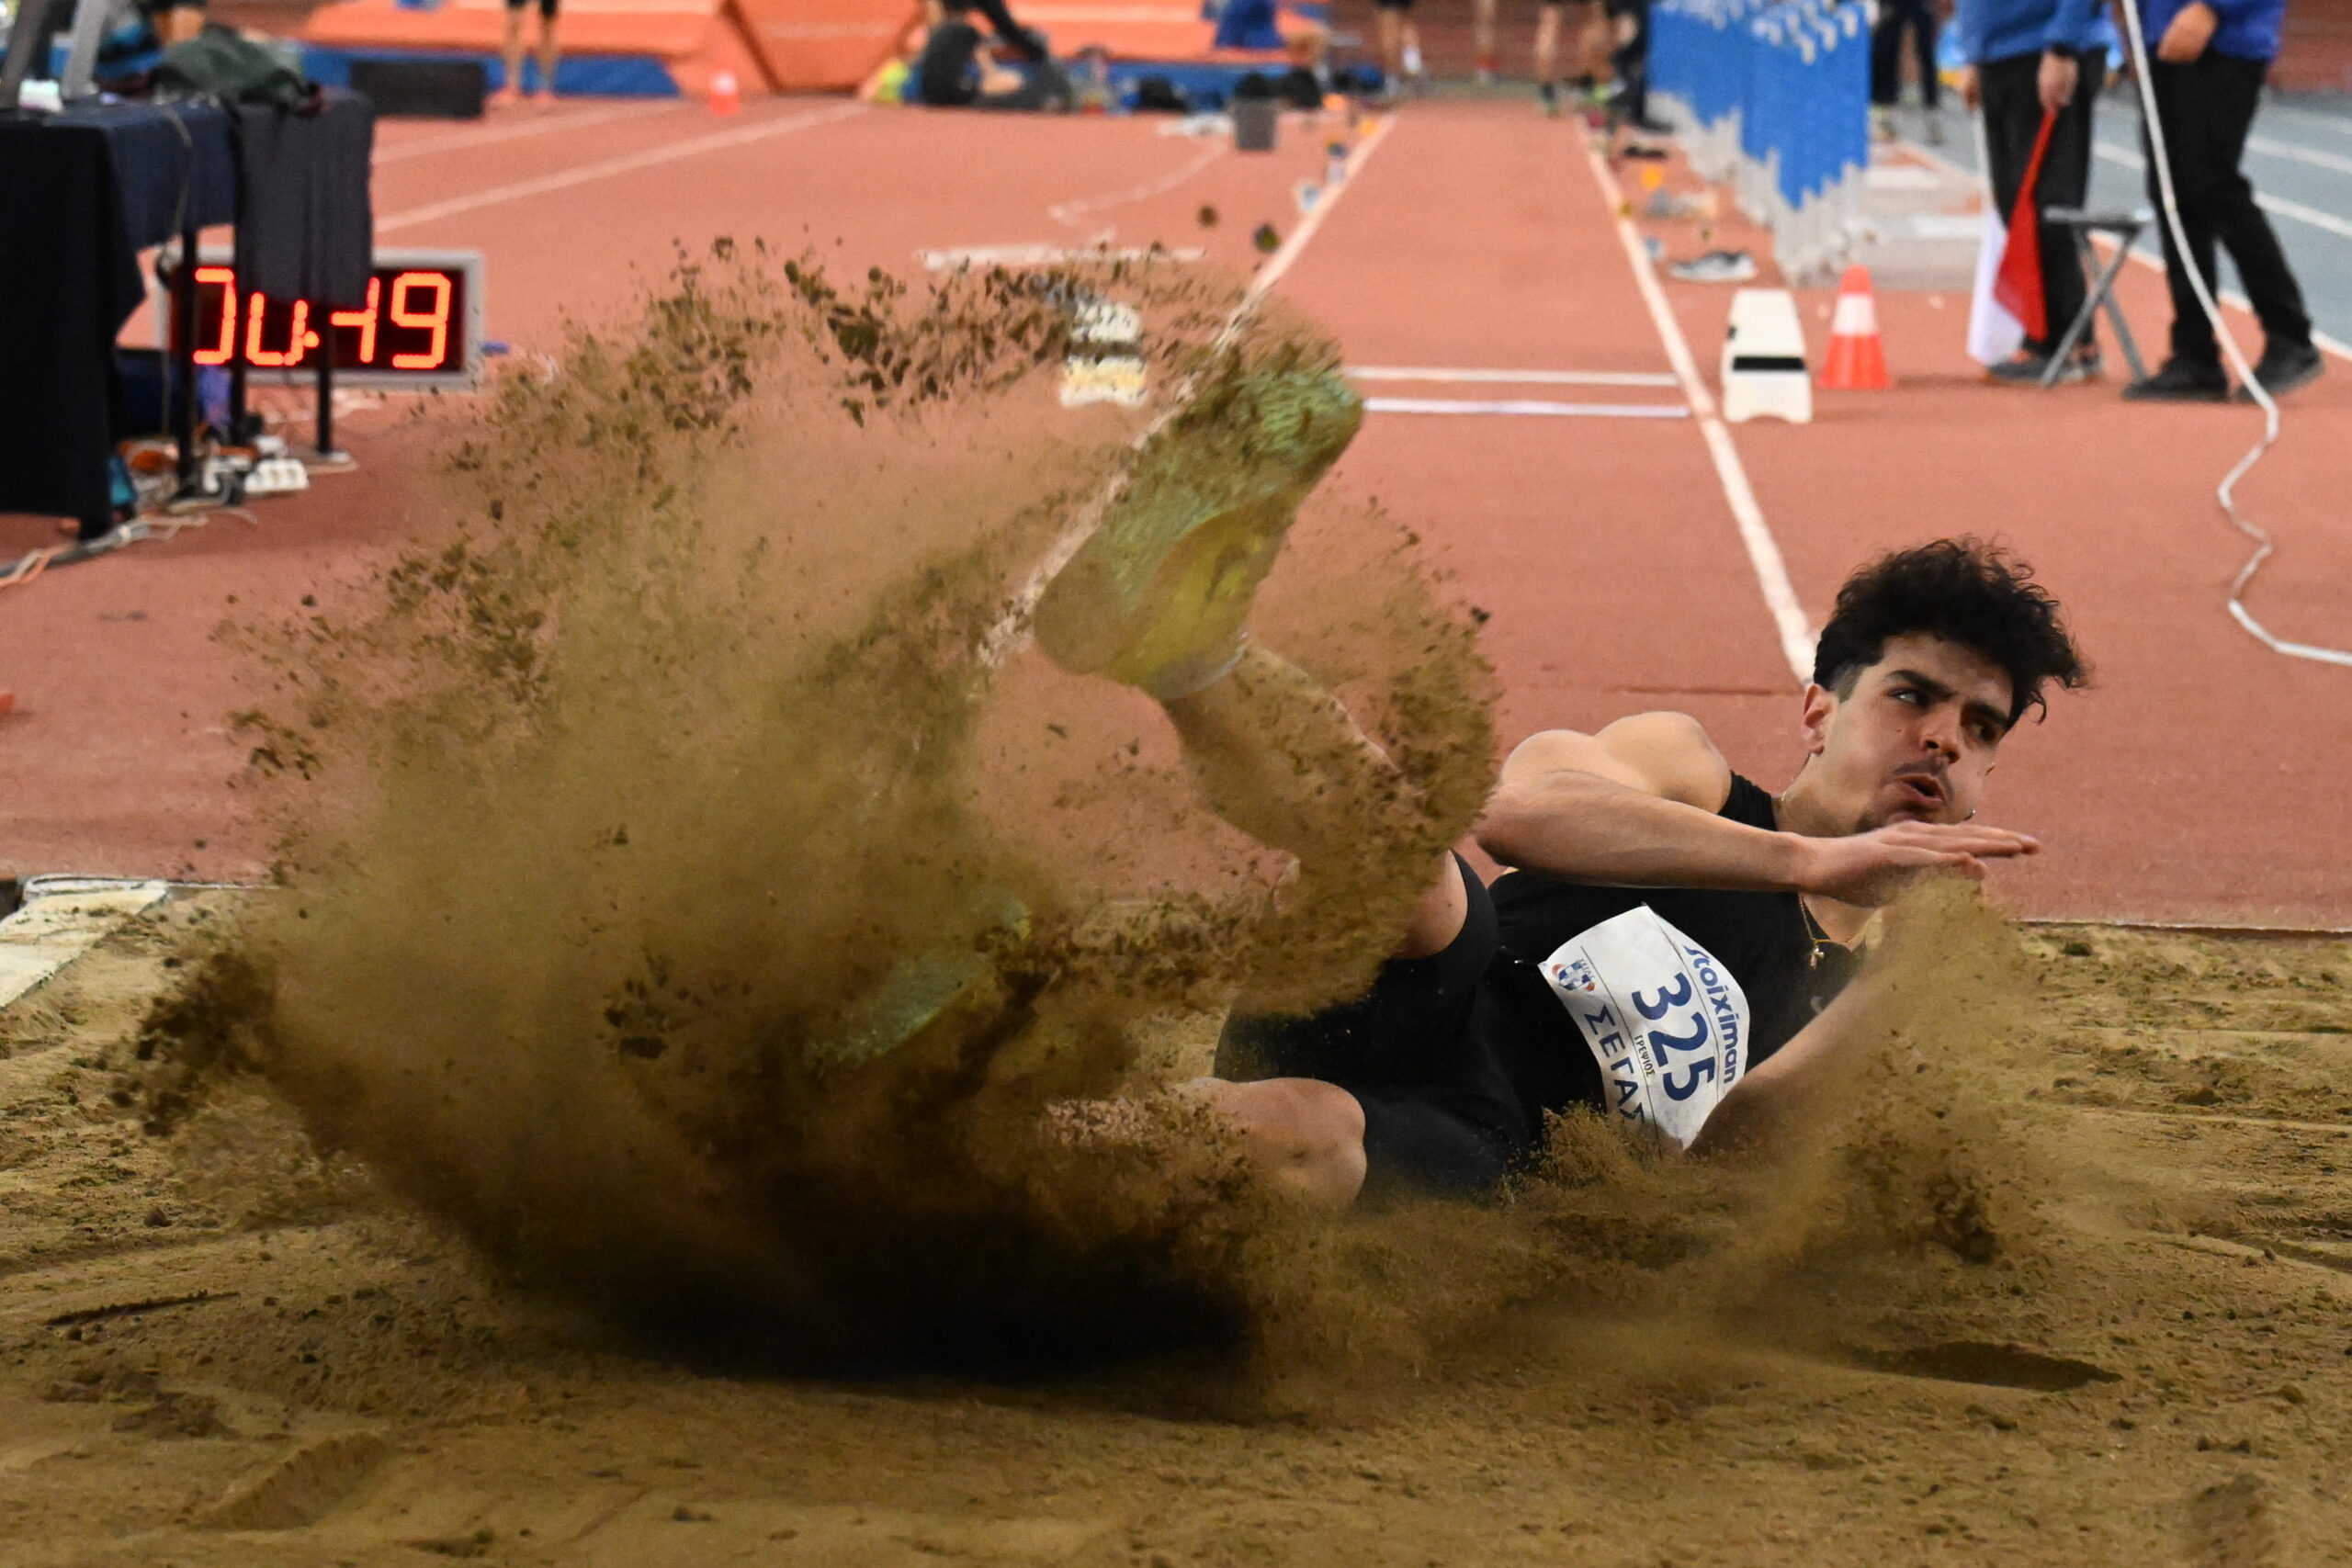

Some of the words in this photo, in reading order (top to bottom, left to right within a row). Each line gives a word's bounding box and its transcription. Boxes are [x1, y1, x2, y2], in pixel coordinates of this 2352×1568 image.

[1583, 1005, 1645, 1125] ΣΕΓΑΣ
[1631, 972, 1716, 1102] 325
[1634, 1034, 1656, 1078] ΓΡΕΨΙΟΣ
